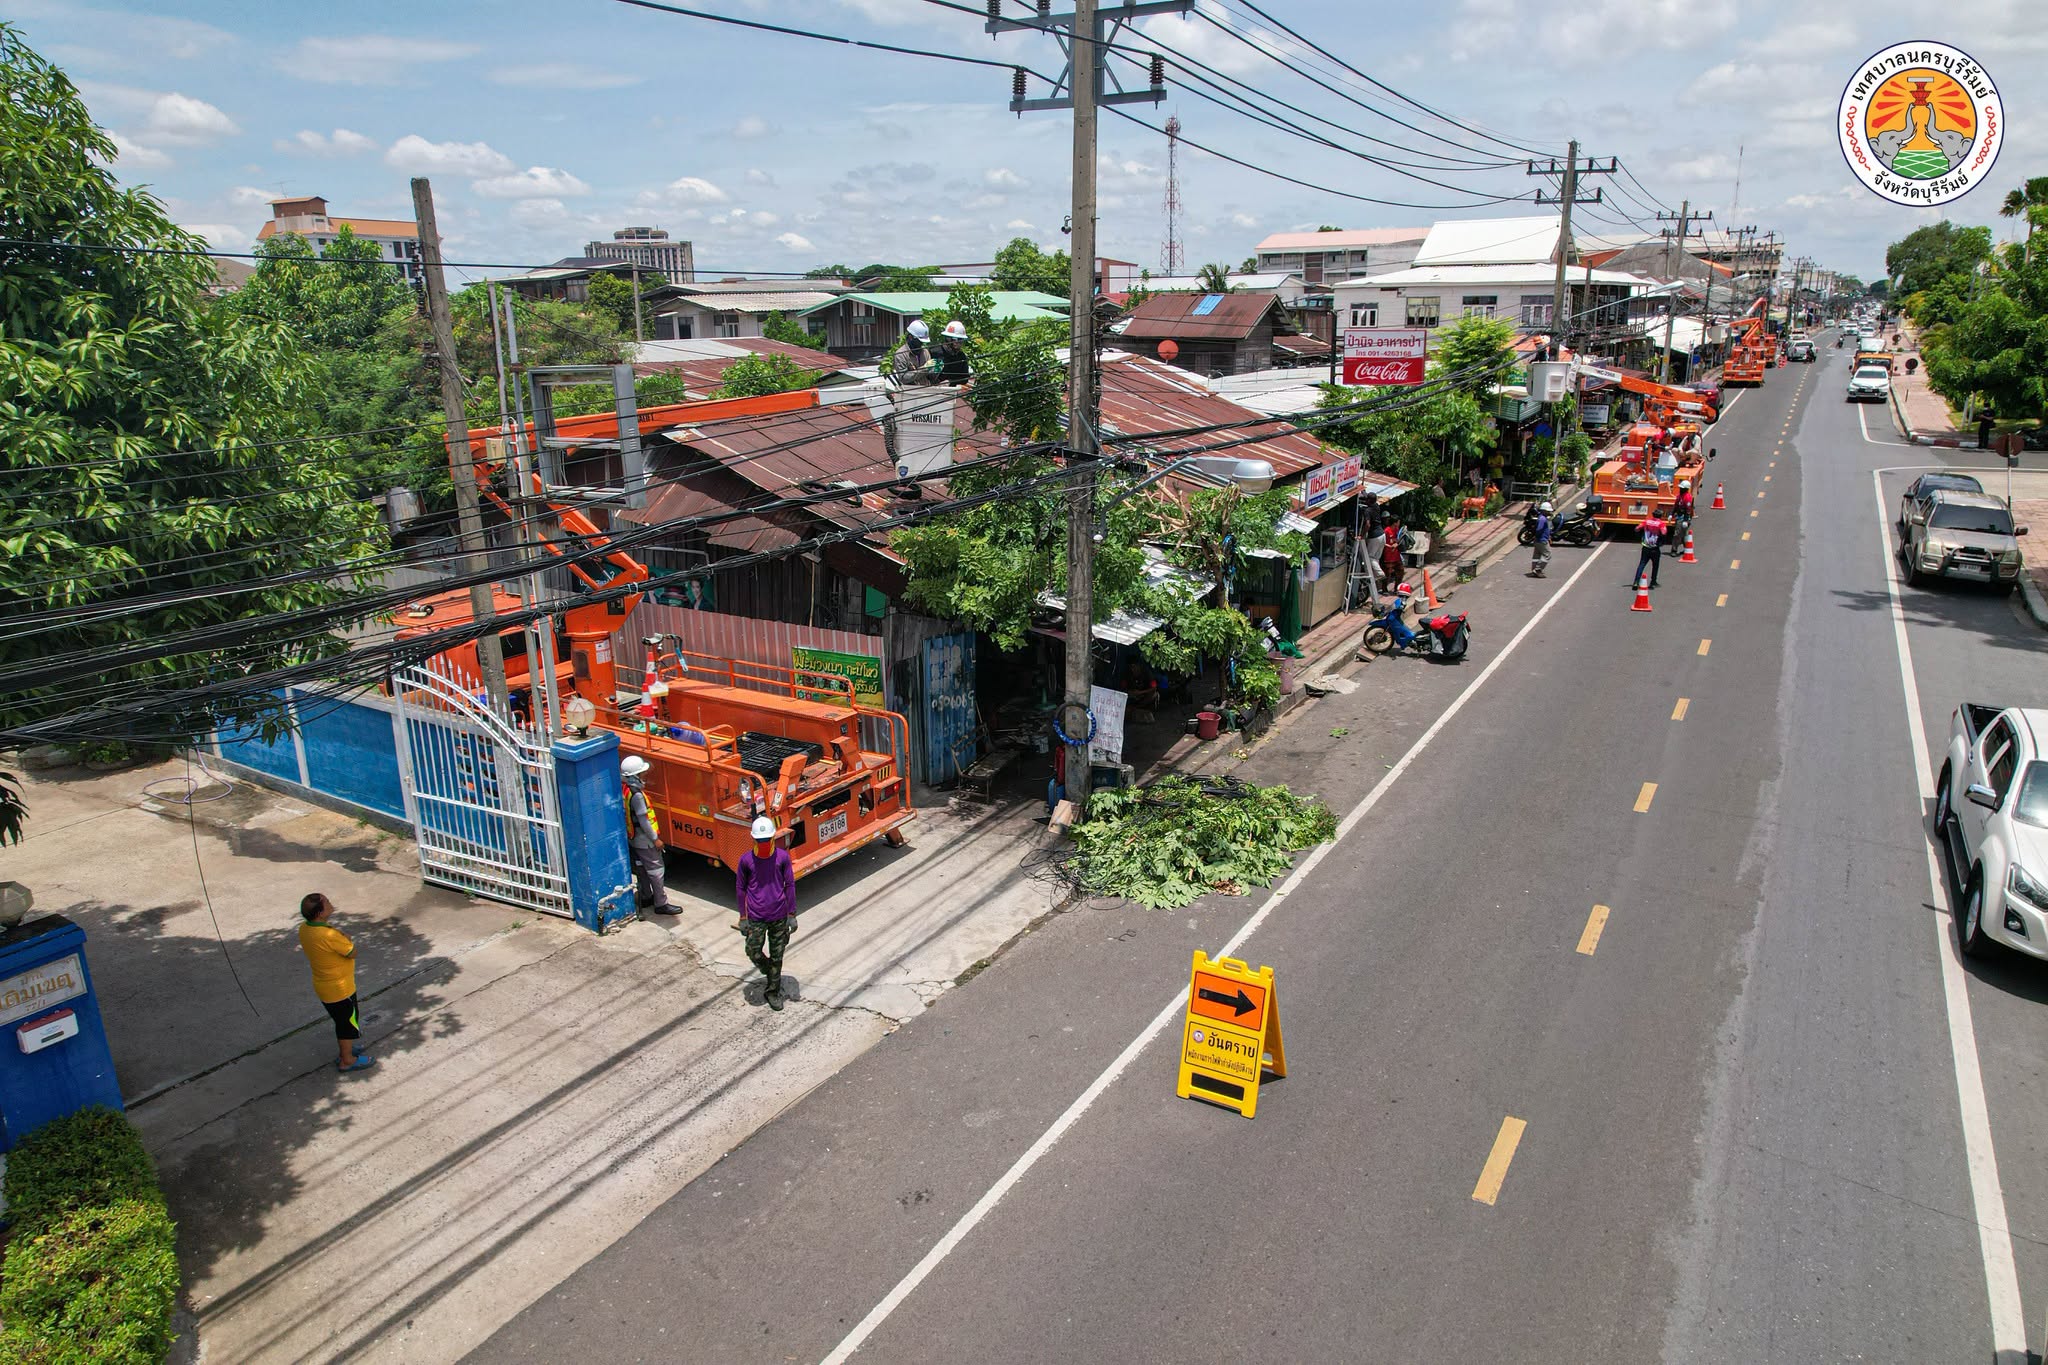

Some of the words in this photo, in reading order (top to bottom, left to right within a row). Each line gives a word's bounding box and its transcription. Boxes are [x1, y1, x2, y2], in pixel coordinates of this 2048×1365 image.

[1377, 334, 1421, 348] อาหารป่า
[1354, 361, 1413, 381] Coca-Cola
[911, 413, 942, 424] VERSALIFT
[1206, 1031, 1256, 1058] อันตราย
